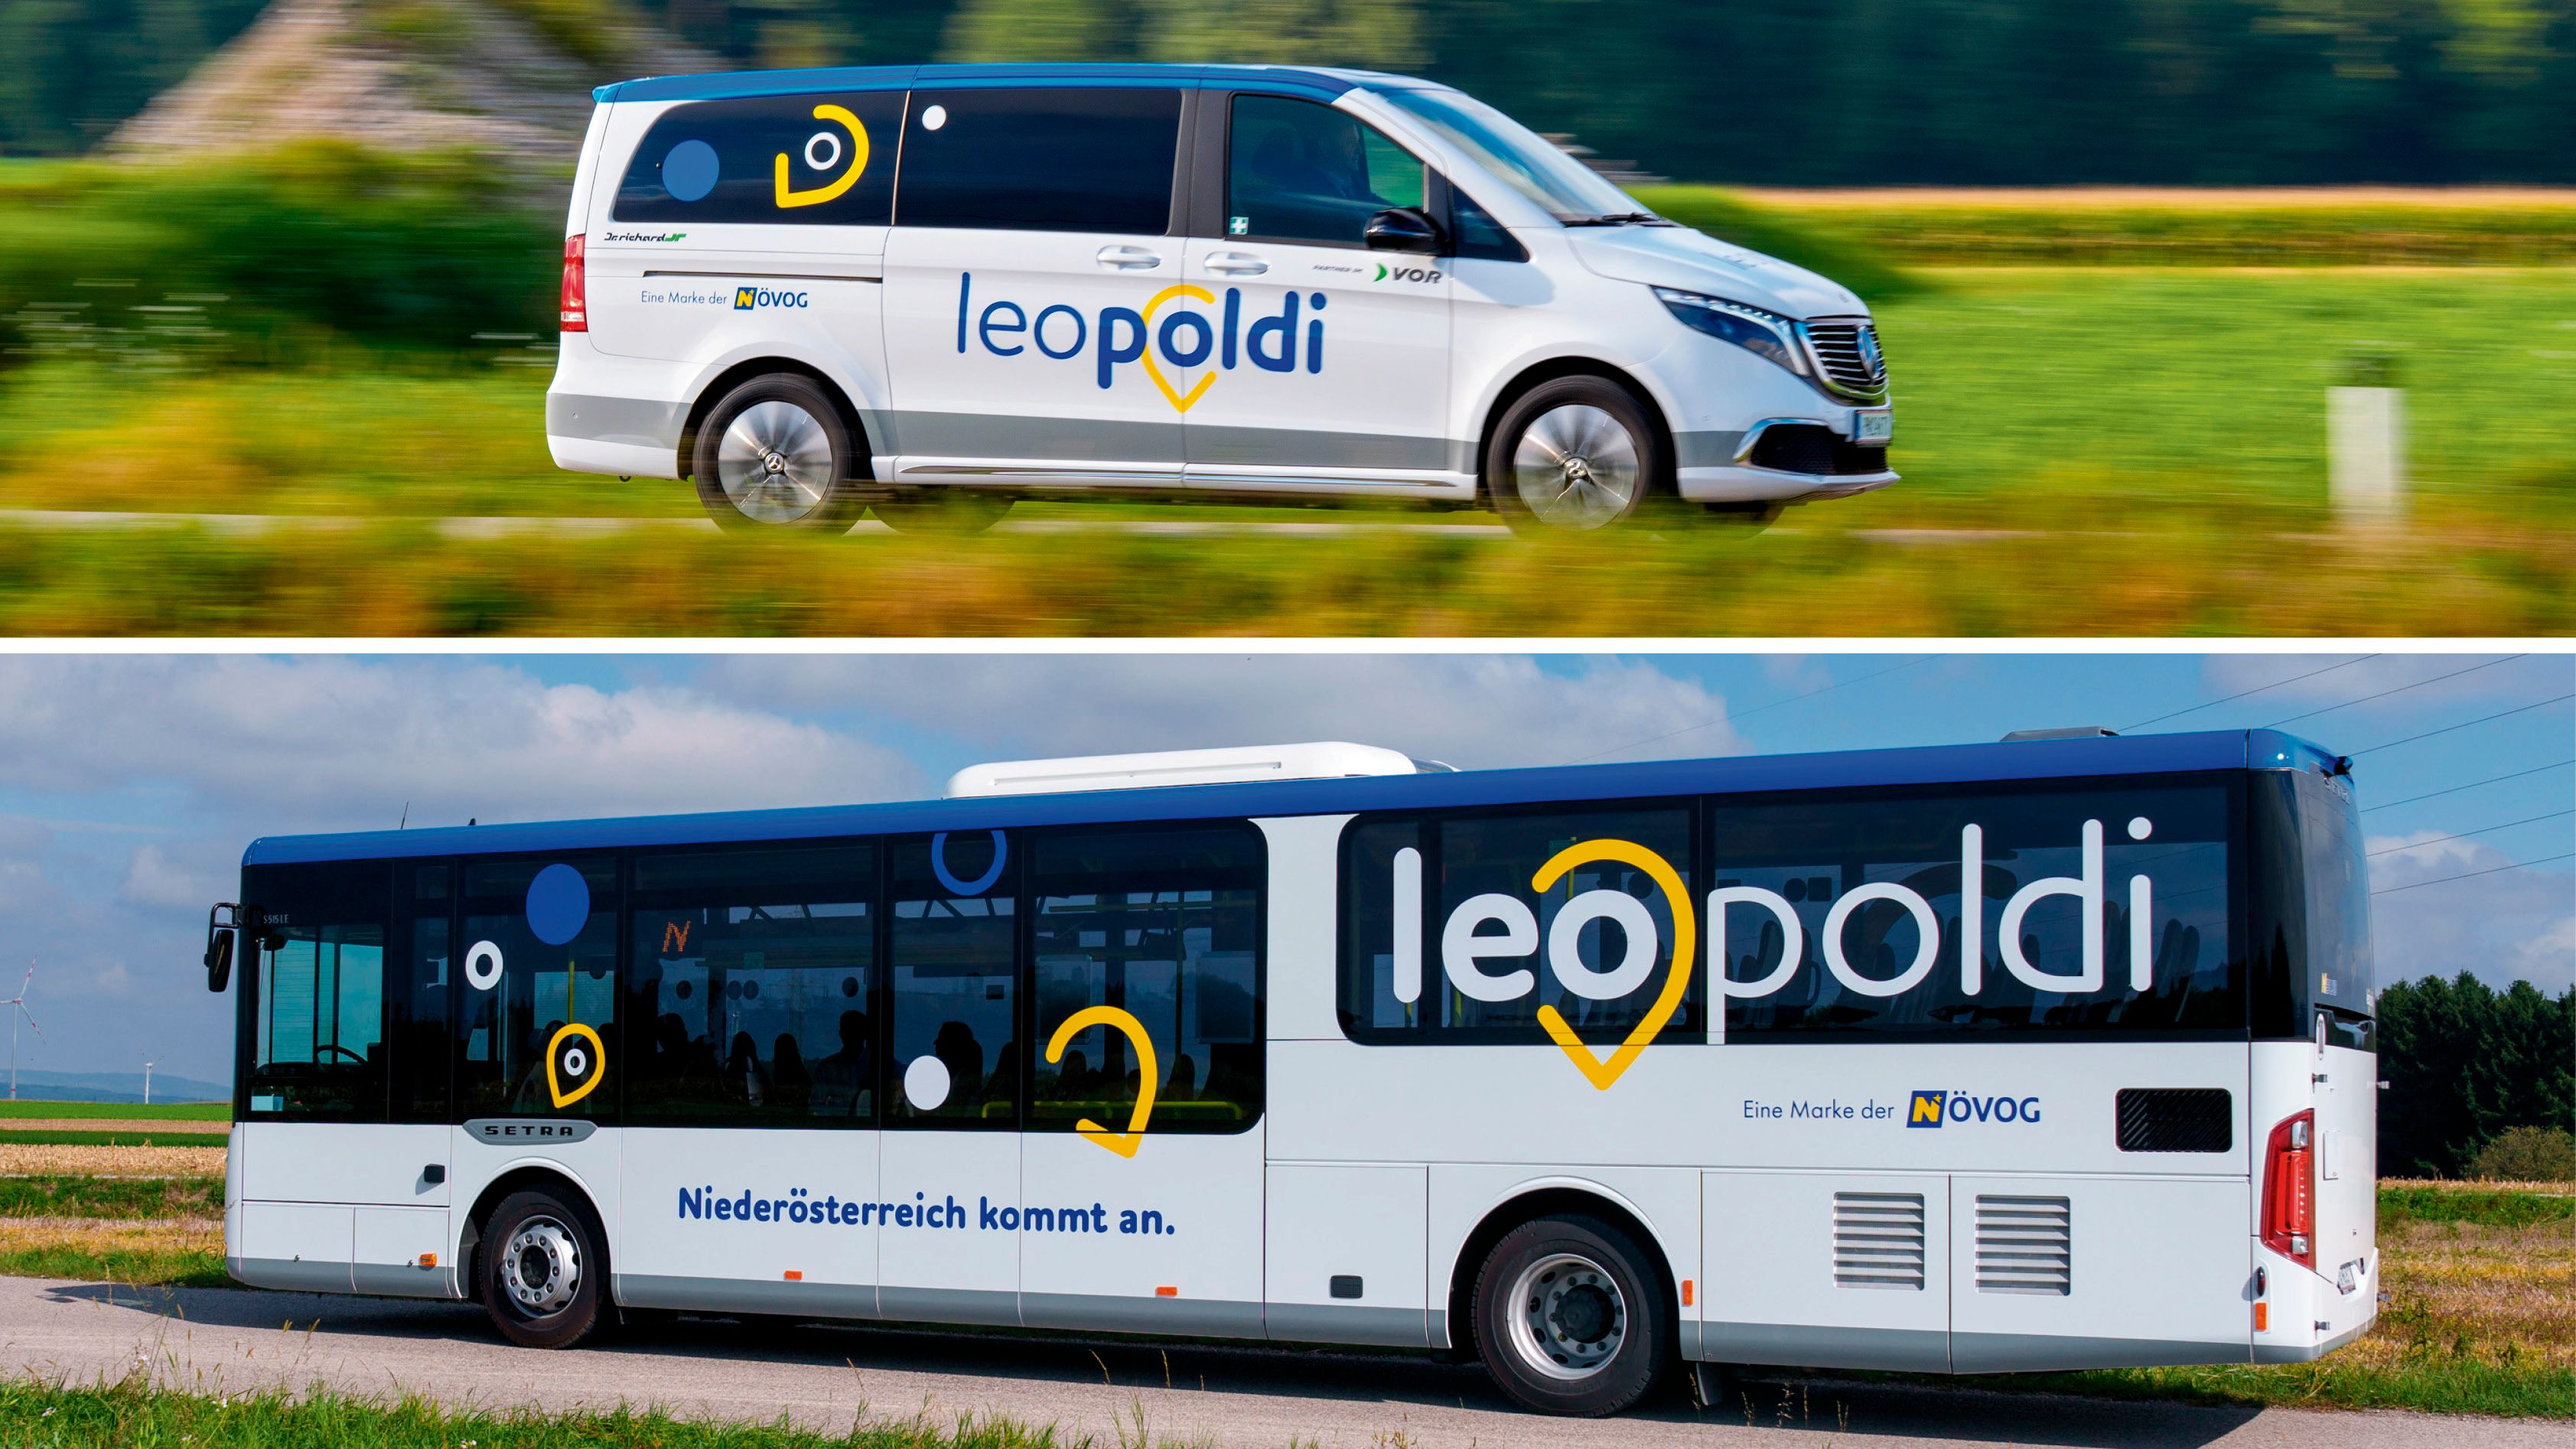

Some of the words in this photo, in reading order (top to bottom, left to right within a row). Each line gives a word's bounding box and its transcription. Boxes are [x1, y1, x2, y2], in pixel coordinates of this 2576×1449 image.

[1393, 267, 1442, 284] VOR
[641, 290, 665, 304] Eine
[668, 290, 705, 304] Marke
[708, 291, 728, 304] der
[957, 272, 1327, 389] leopoldi
[1393, 817, 2152, 1044] leopoldi
[1744, 1099, 1783, 1119] Eine
[1790, 1098, 1855, 1119] Marke
[1861, 1098, 1895, 1119] der
[484, 1125, 573, 1136] SETRA
[679, 1185, 966, 1229] Niederösterreich
[979, 1196, 1108, 1233] kommt
[1119, 1210, 1175, 1236] an.
